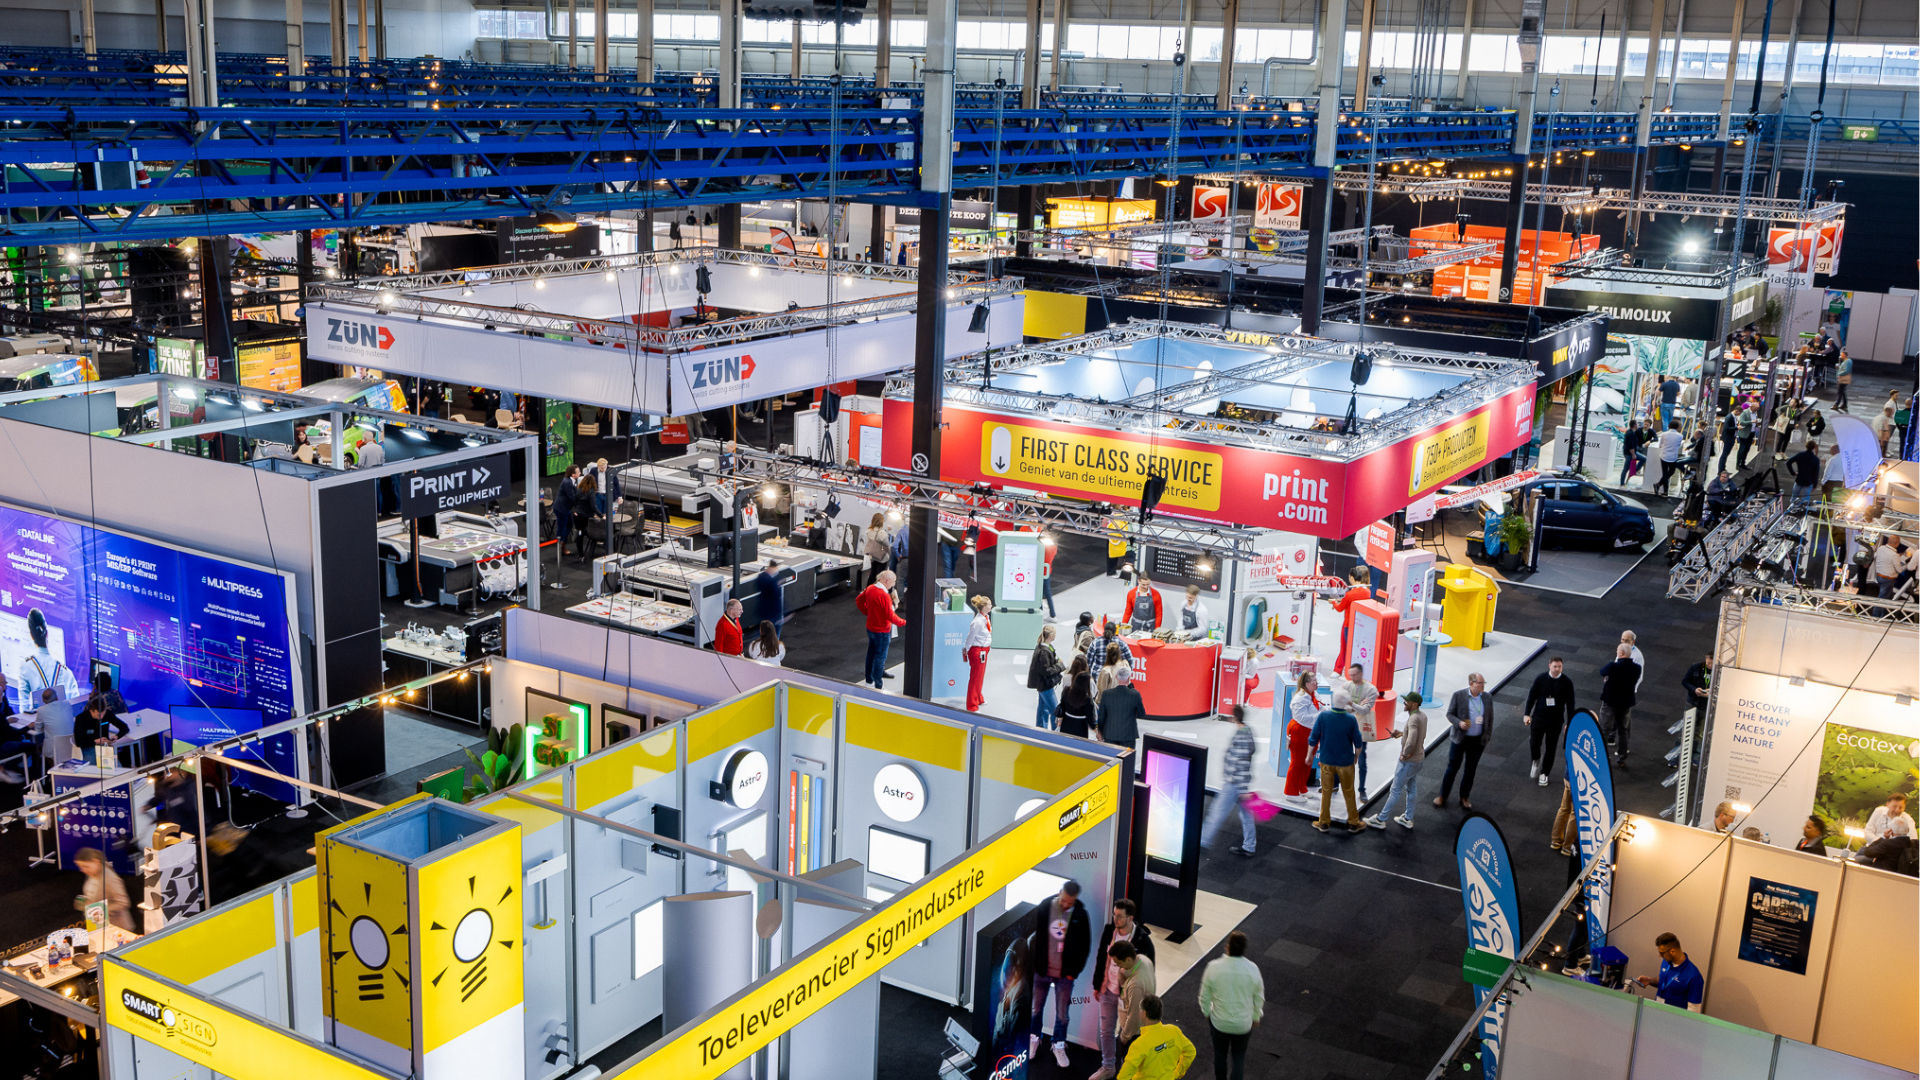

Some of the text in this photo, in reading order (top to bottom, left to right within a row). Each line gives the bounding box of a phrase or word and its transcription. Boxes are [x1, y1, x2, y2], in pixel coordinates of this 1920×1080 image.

[899, 208, 918, 216] DEZE
[952, 211, 963, 219] TE
[1268, 217, 1299, 228] Maegis
[1763, 273, 1806, 287] Maegis
[1602, 306, 1671, 323] FILMOLUX
[159, 345, 191, 360] THE WRAP
[345, 345, 365, 356] cutting
[366, 350, 389, 359] systems
[1578, 337, 1591, 354] VTS
[708, 386, 728, 396] cutting
[728, 382, 750, 392] systems
[1021, 436, 1213, 486] FIRST CLASS SERVICE
[410, 471, 467, 499] PRINT
[1019, 461, 1198, 500] Geniet van de ultieme ntreis
[1263, 469, 1329, 504] print
[438, 485, 502, 509] EQUIPMENT
[1278, 502, 1328, 524] .com
[21, 528, 55, 545] DATALINE
[106, 560, 158, 580] MIS/ERP Software
[138, 559, 157, 571] PRINT
[1251, 568, 1270, 578] FLYER
[207, 576, 263, 599] MULTIPRESS
[944, 638, 966, 646] WOW.
[1738, 698, 1791, 716] DISCOVER
[1737, 710, 1791, 727] THE MANY
[1734, 722, 1782, 738] FACES OF
[1733, 734, 1774, 750] NATURE
[1837, 733, 1898, 755] ecotex
[1059, 807, 1081, 828] SMART
[1070, 852, 1098, 860] NIEUW
[1751, 891, 1810, 922] CARBON
[1467, 947, 1476, 955] E02
[699, 869, 984, 1066] Toeleverancier Signindustrie
[123, 993, 212, 1041] SMART SIGN
[989, 1049, 1027, 1080] Cosmos
